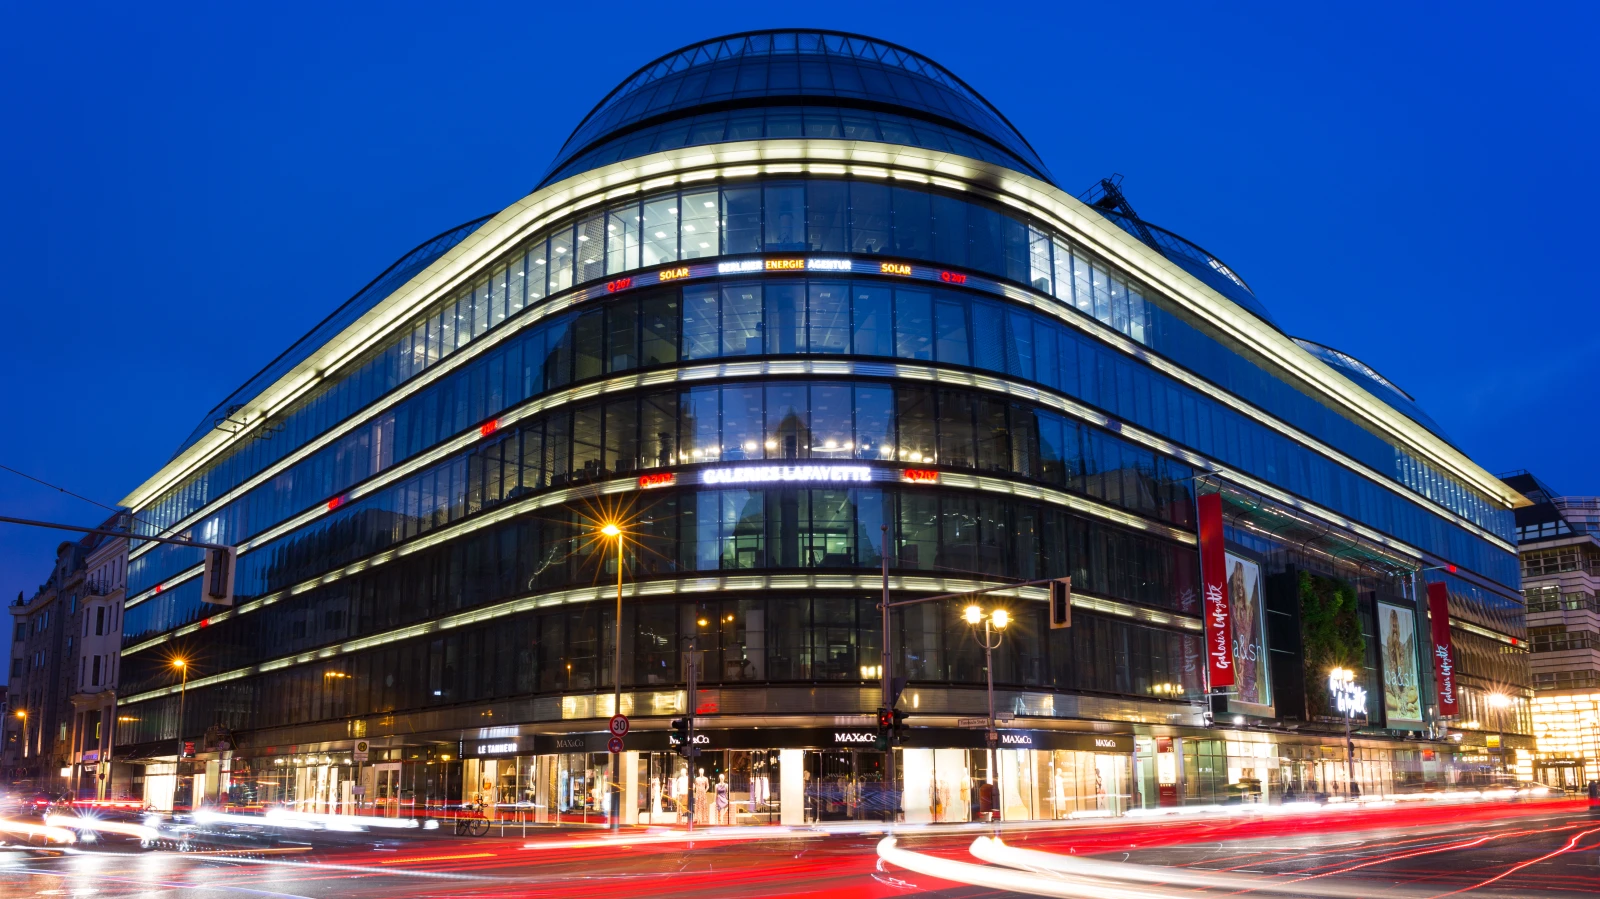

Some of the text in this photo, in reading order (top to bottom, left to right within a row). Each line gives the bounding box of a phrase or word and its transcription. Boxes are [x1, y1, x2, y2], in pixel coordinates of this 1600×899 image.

[765, 259, 805, 270] ENERGIE
[807, 258, 851, 271] AGENTUR
[881, 263, 911, 275] SOLAR
[659, 267, 689, 281] SOLAR
[703, 465, 872, 483] GALERIES LAFAYETTE
[1206, 582, 1231, 669] Galeries Lafayette
[1233, 634, 1264, 663] a&sh
[1435, 644, 1455, 704] Galeries Lafayette
[613, 720, 626, 731] 30
[477, 743, 518, 754] LE TANNEUR
